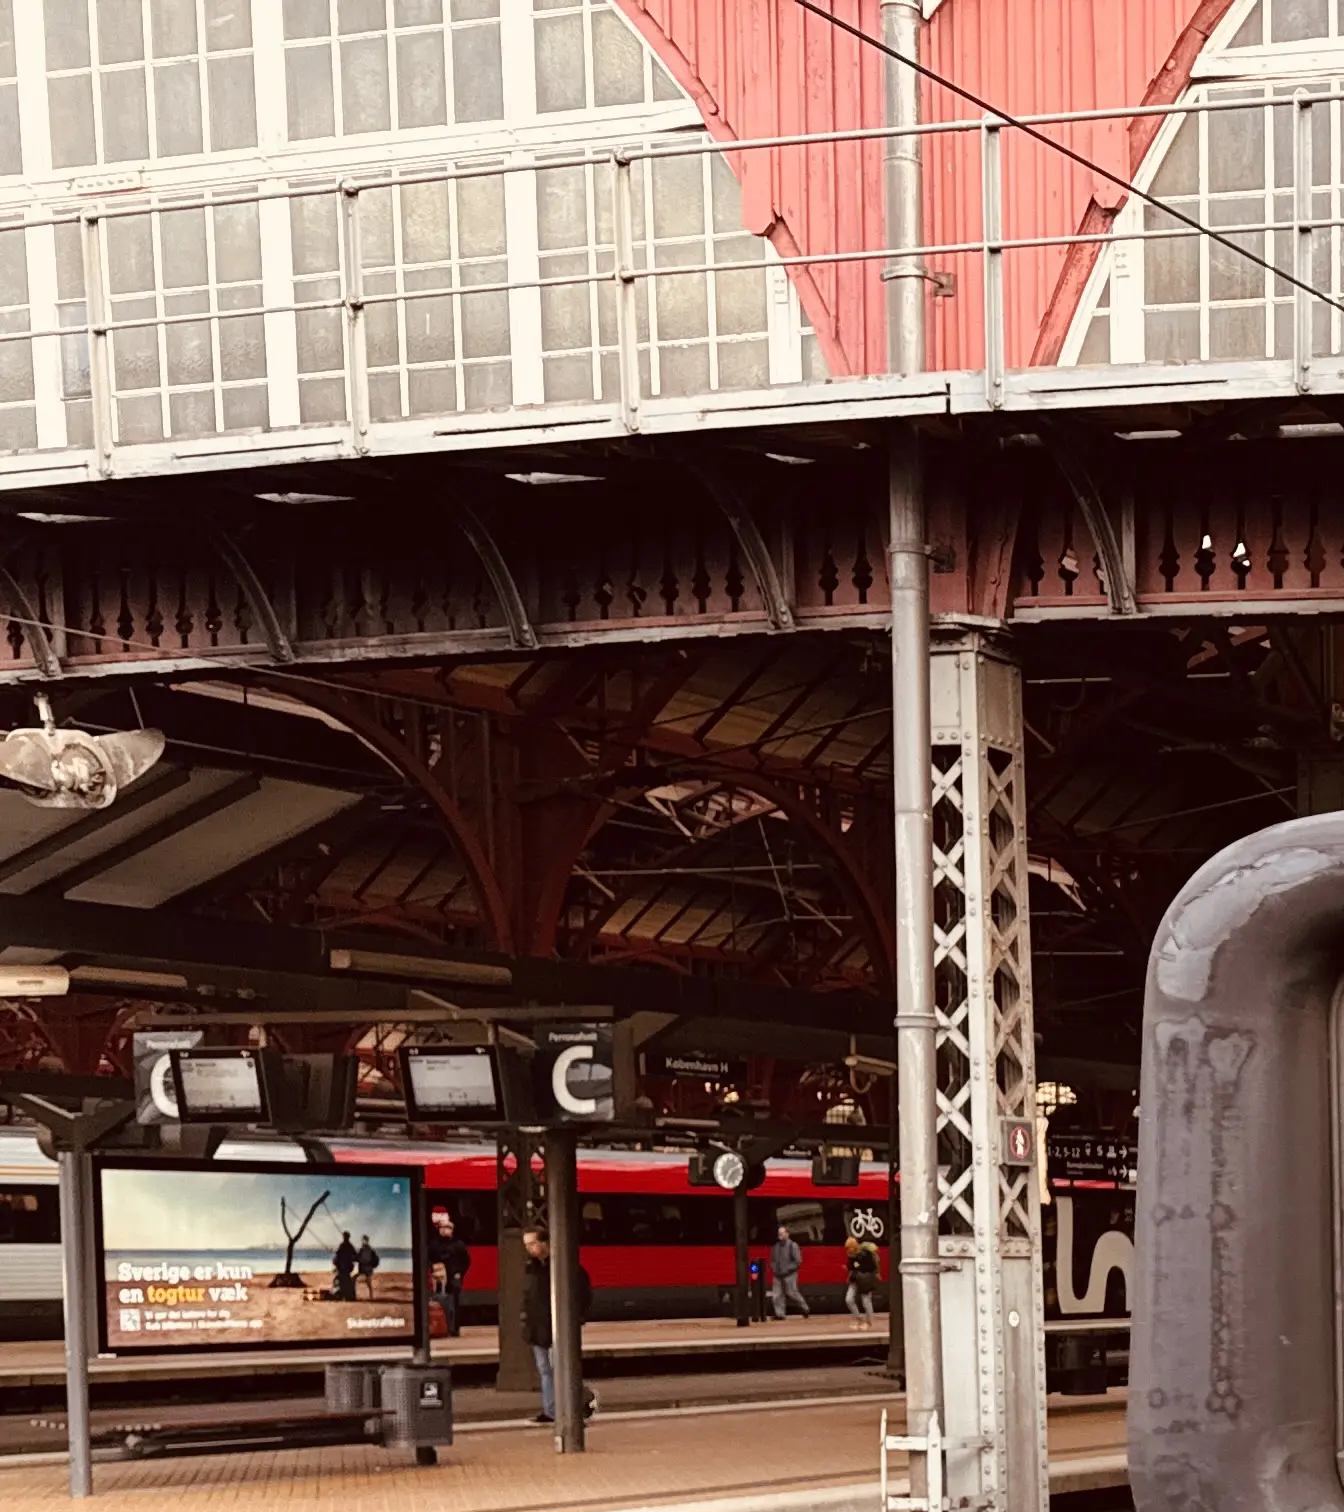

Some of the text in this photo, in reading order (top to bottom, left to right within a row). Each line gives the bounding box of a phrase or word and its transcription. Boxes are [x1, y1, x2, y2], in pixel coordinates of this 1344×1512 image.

[665, 1056, 718, 1073] København
[552, 1045, 597, 1115] C
[118, 1262, 253, 1285] Sverige er kun
[119, 1283, 249, 1305] en togtur væk
